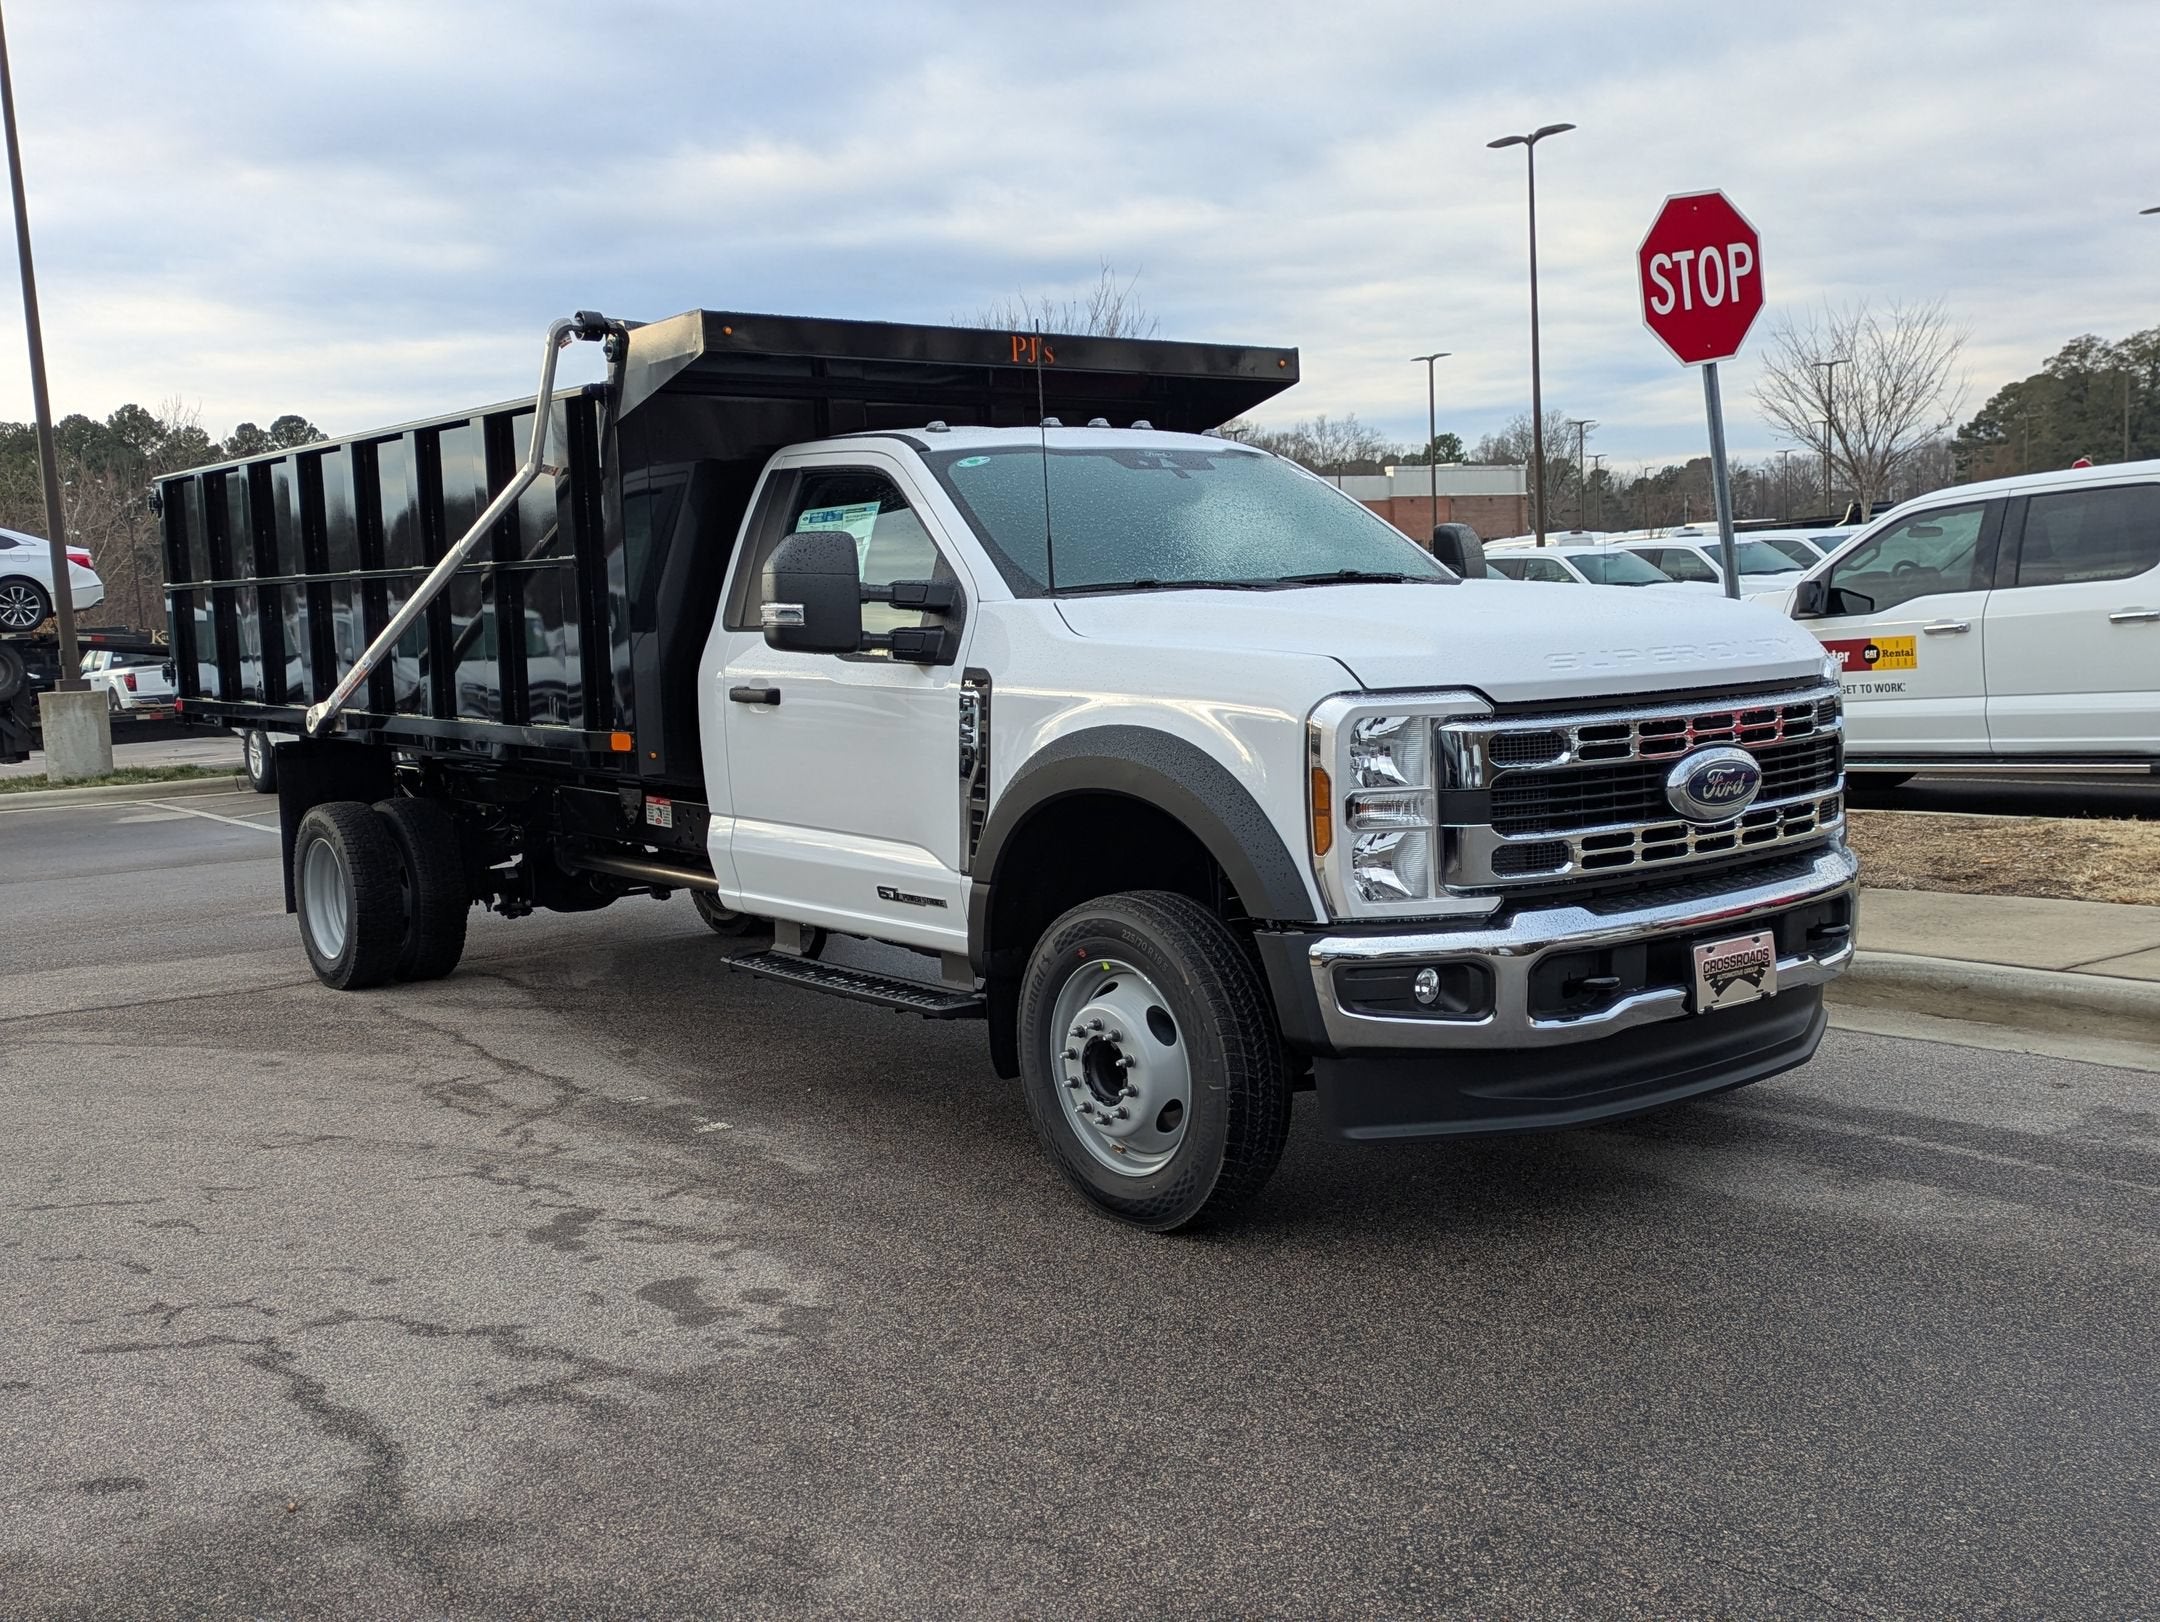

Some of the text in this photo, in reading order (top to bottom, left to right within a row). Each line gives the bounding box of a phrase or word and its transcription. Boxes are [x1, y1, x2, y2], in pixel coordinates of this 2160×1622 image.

[1650, 242, 1753, 315] STOP
[1864, 649, 1877, 659] CAT
[1881, 648, 1914, 658] Rental
[964, 680, 975, 688] XL
[1860, 684, 1872, 694] TO
[1703, 768, 1745, 800] Ford
[1702, 948, 1769, 974] CROSSROADS
